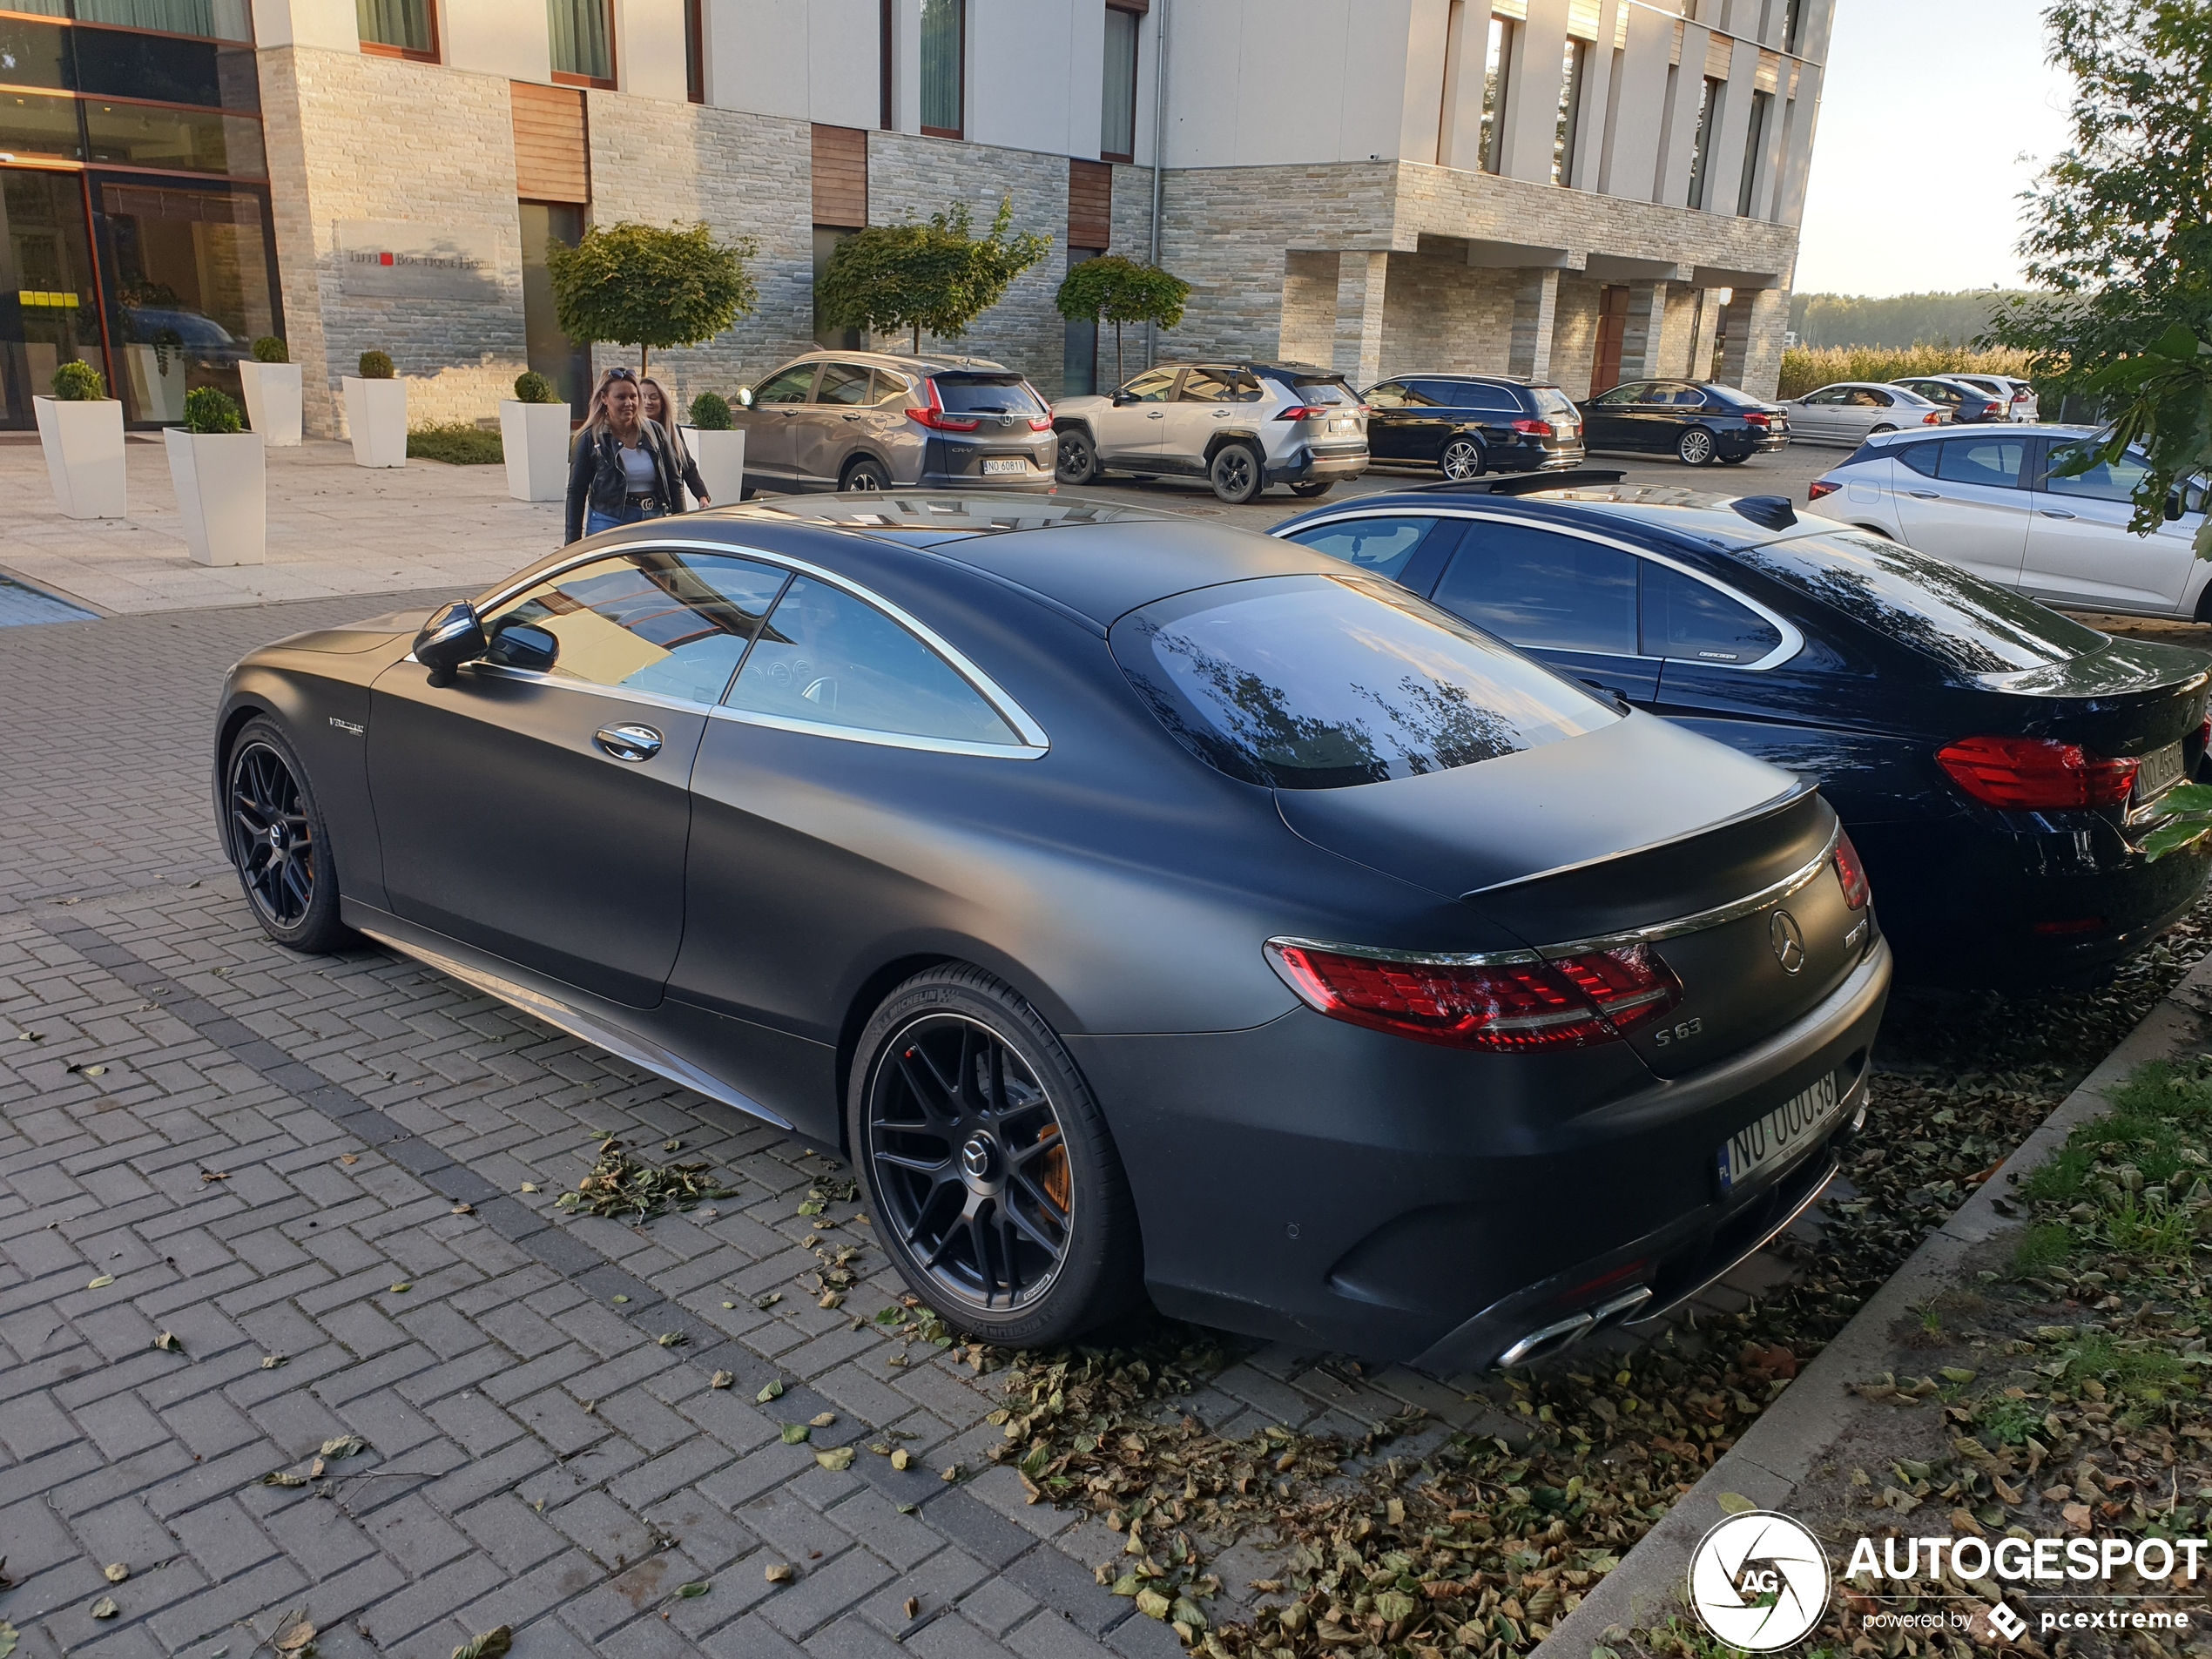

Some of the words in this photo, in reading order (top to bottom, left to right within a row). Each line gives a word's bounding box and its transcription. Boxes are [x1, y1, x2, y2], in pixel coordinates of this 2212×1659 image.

[1001, 460, 1023, 471] 6081V
[889, 990, 937, 1016] MICHELIN
[1656, 1029, 1670, 1047] S
[1675, 1017, 1702, 1040] 63
[1719, 1165, 1729, 1181] PL
